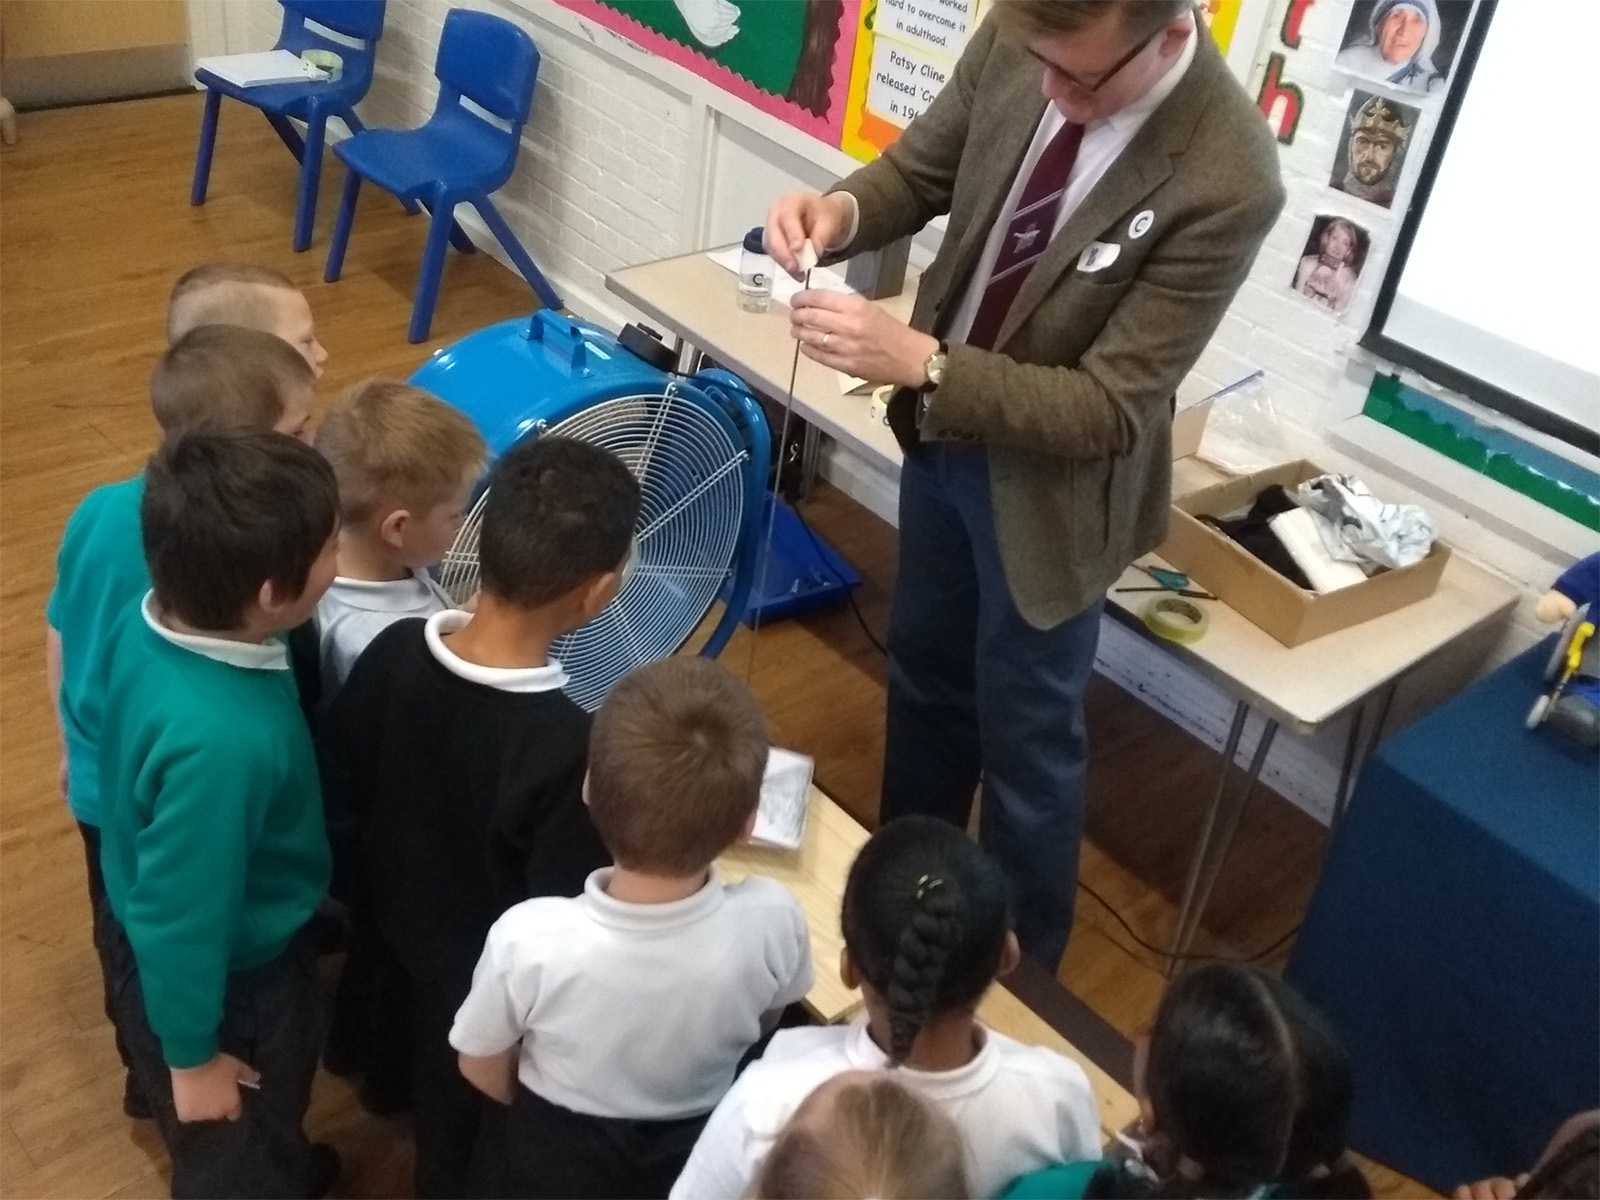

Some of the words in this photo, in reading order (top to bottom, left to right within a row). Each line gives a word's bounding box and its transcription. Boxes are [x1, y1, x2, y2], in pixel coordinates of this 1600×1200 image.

[907, 3, 915, 13] to
[918, 9, 956, 30] overcome
[959, 22, 966, 32] it
[896, 18, 904, 30] in
[906, 24, 948, 47] adulthood.
[890, 51, 916, 74] Patsy
[920, 64, 945, 83] Cline
[876, 72, 916, 96] released
[889, 100, 898, 113] in
[1135, 216, 1149, 233] C
[752, 273, 764, 286] C
